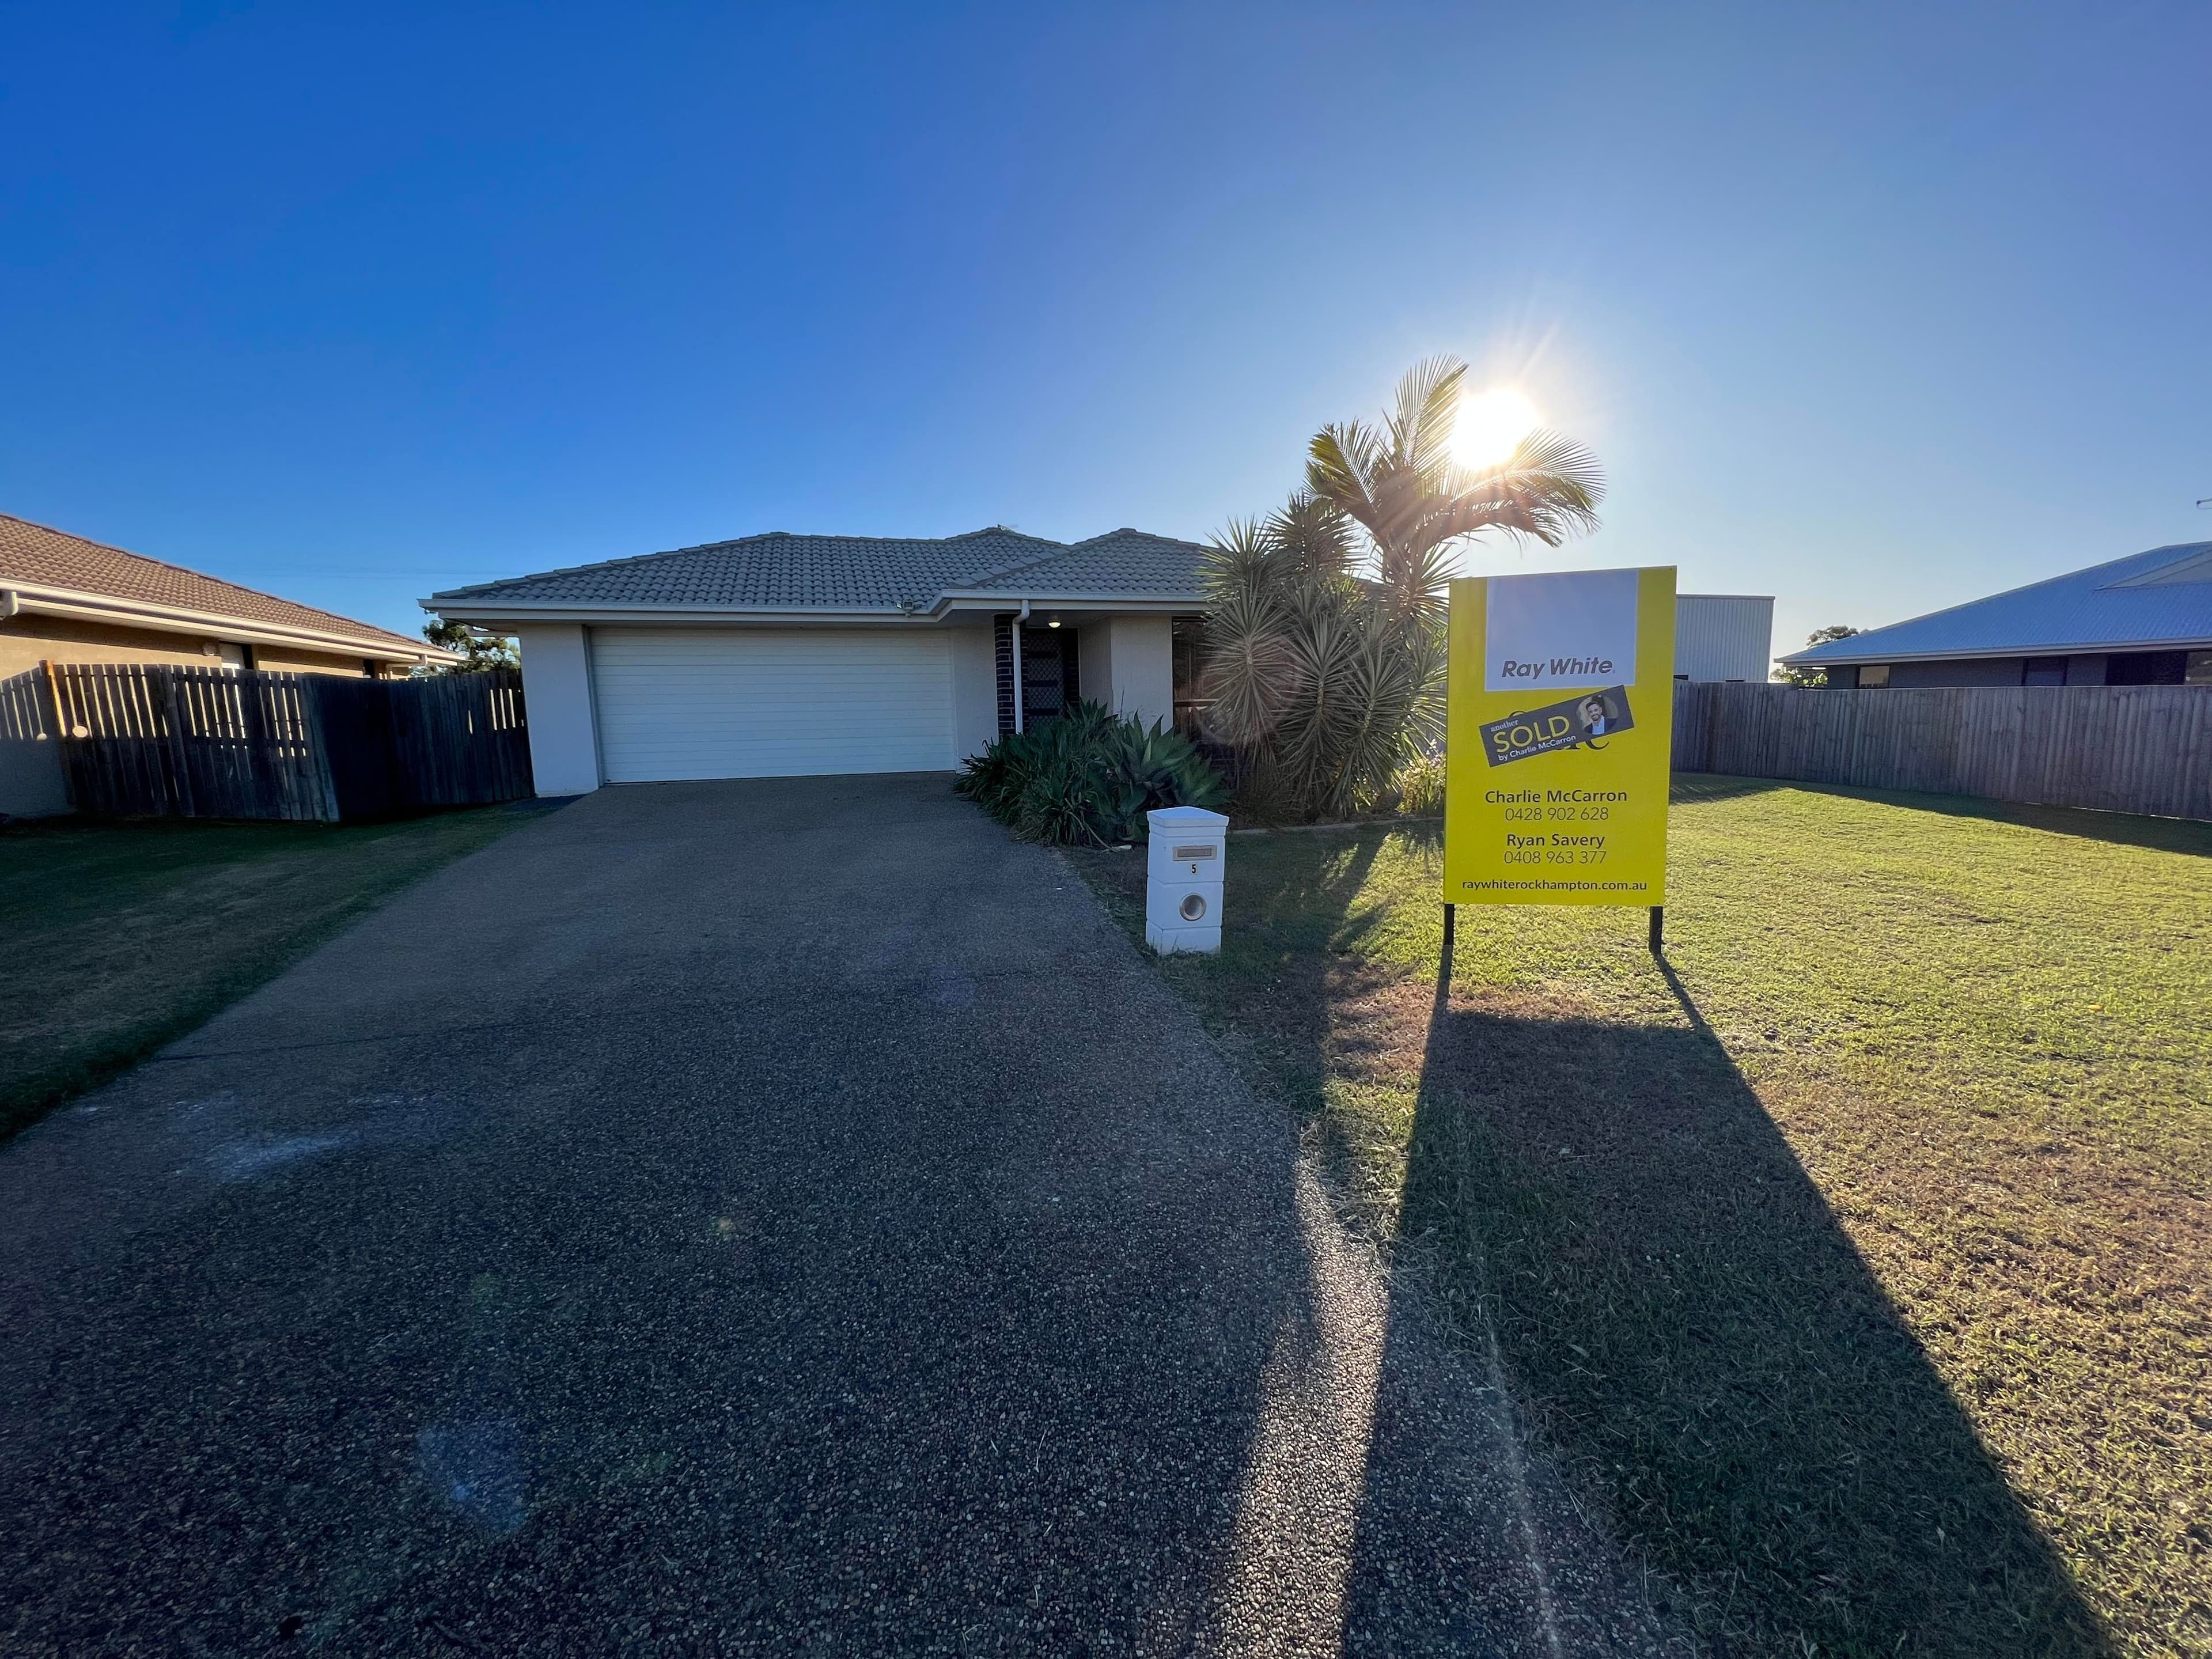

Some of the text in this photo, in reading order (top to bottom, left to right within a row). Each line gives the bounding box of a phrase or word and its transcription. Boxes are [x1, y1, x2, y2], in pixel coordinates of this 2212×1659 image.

[1502, 656, 1613, 680] Ray White
[1491, 719, 1520, 732] another
[1493, 715, 1570, 753] SOLD
[1498, 734, 1577, 762] by Charlie McCarron
[1485, 790, 1627, 804] Charlie McCarron
[1505, 807, 1609, 821] 0428 902 628
[1507, 834, 1605, 849] Ryan Savery
[1504, 851, 1607, 864] 0408 963 377
[1192, 864, 1196, 873] 5
[1462, 879, 1647, 891] raywhiterockhampton.com.au
